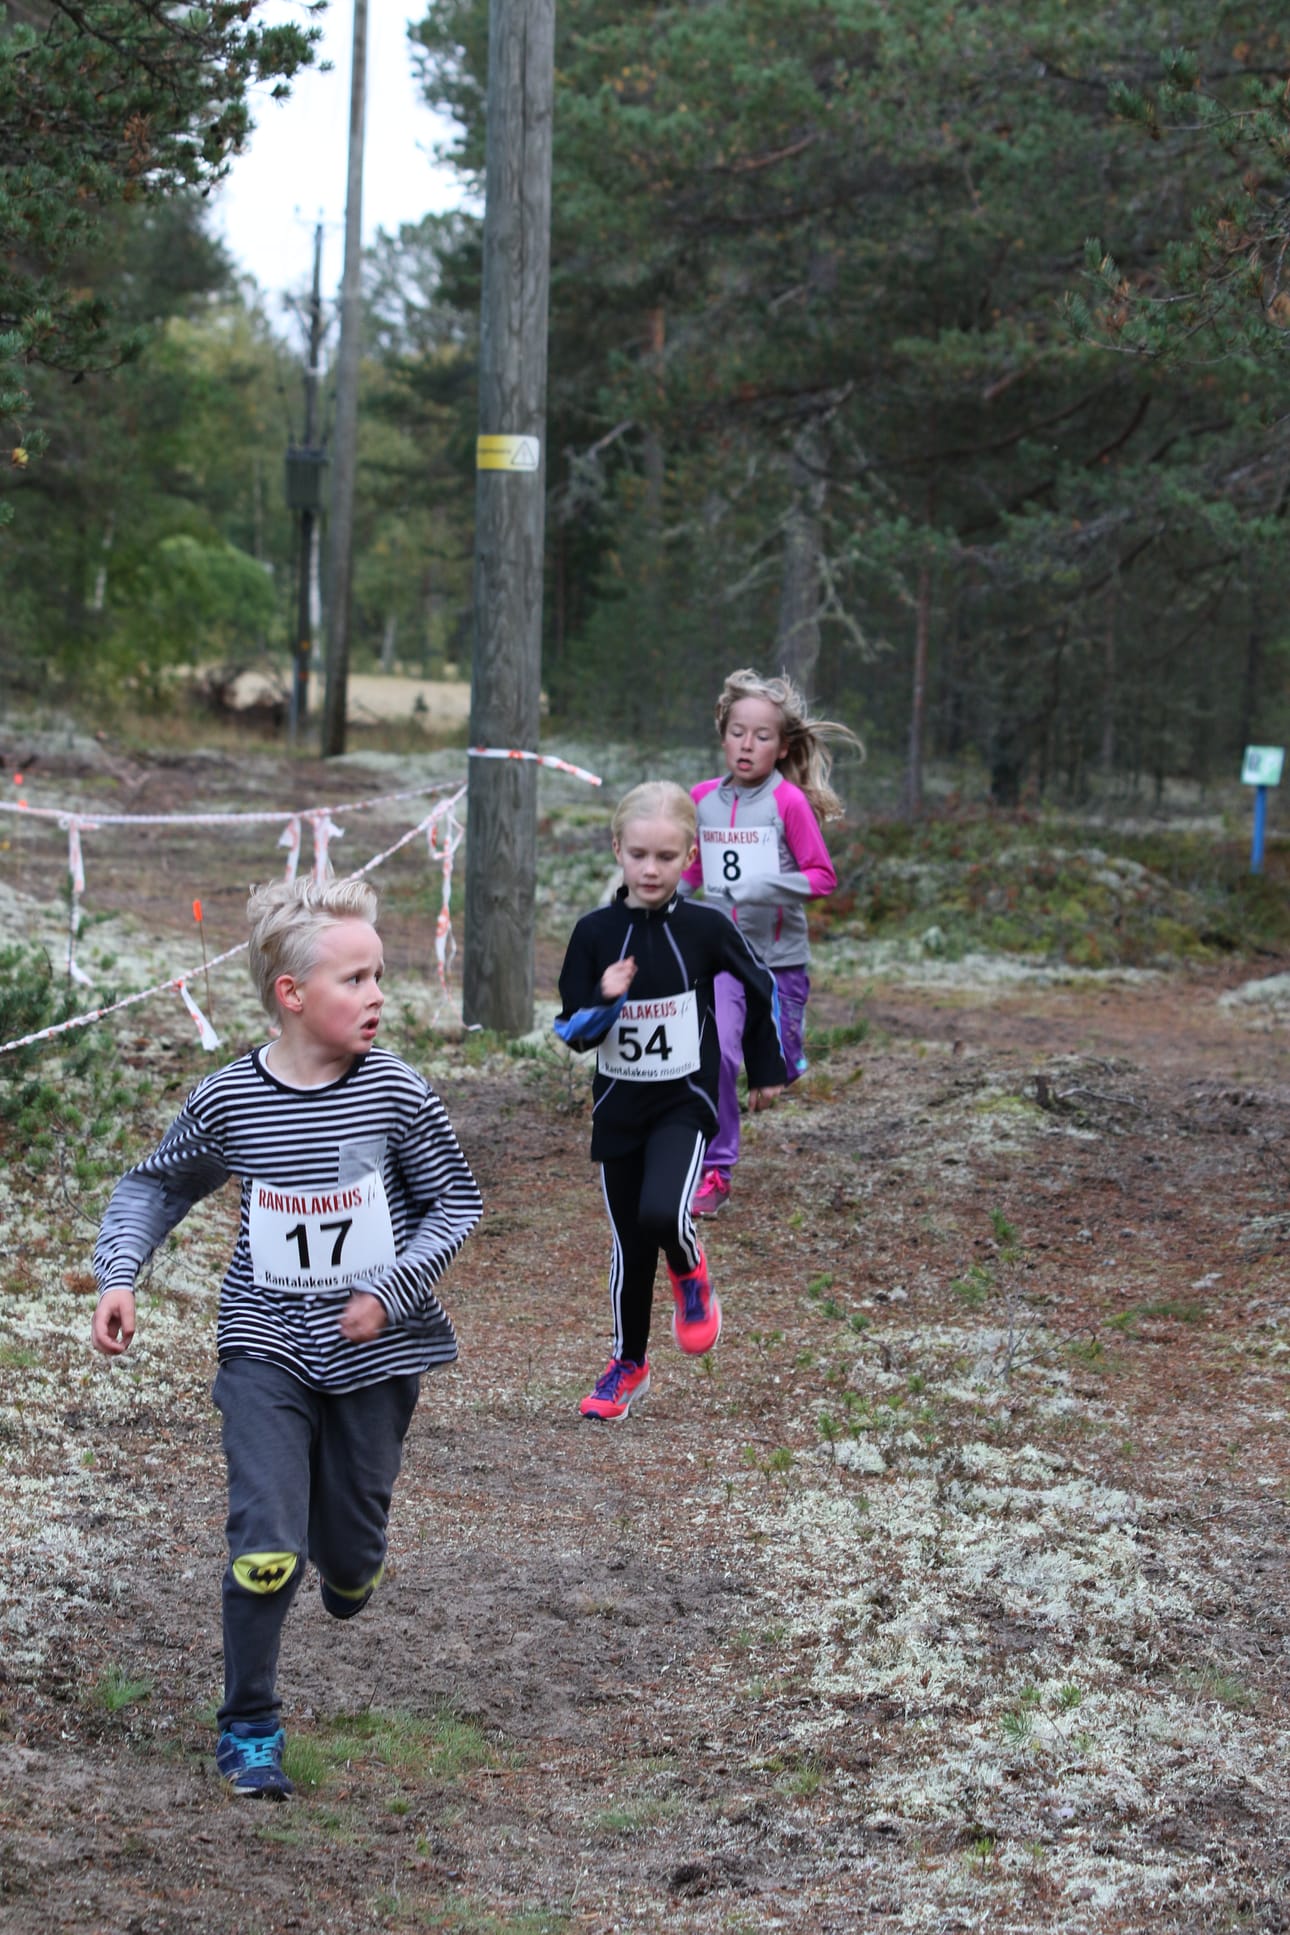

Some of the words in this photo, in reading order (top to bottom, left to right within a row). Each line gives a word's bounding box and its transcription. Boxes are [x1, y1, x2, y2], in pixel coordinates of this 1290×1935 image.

[723, 850, 741, 881] 8
[621, 1001, 677, 1020] ALAKEUS
[618, 1023, 672, 1062] 54
[258, 1187, 362, 1216] RANTALAKEUS
[286, 1218, 353, 1270] 17
[265, 1271, 339, 1289] Rantalakeus
